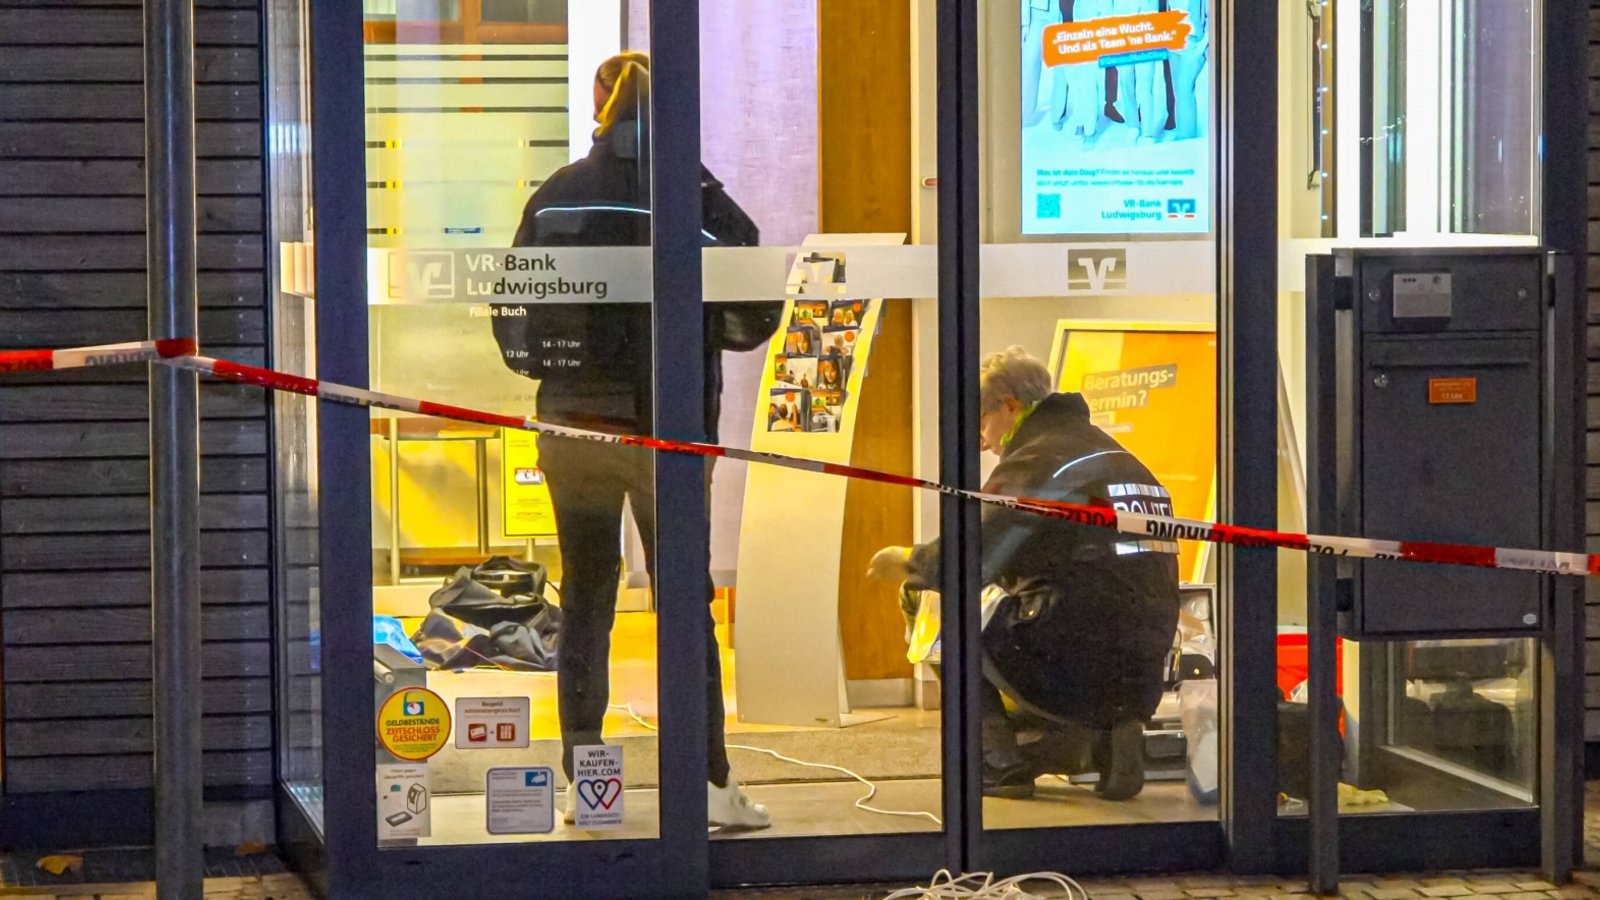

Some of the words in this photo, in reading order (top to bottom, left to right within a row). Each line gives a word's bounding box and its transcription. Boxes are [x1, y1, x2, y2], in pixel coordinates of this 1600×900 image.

[1096, 28, 1117, 38] eine
[1119, 22, 1154, 35] Wucht.
[1058, 42, 1080, 55] Und
[1082, 41, 1097, 52] als
[1100, 38, 1126, 50] Team
[1101, 210, 1162, 220] Ludwigsburg
[466, 277, 608, 299] Ludwigsburg
[501, 306, 527, 317] Buch
[542, 340, 551, 348] 14
[557, 340, 566, 348] 17
[567, 340, 581, 348] Uhr
[516, 350, 529, 358] Uhr
[542, 359, 551, 367] 14
[557, 359, 566, 367] 17
[567, 359, 581, 367] Uhr
[1084, 368, 1174, 391] Beratungs-
[1090, 389, 1147, 411] ermin?
[386, 726, 441, 736] ZEITSCHLOSS
[392, 733, 438, 743] GESICHERT
[587, 750, 610, 758] WIR-
[579, 759, 619, 768] KAUFEN-
[577, 768, 621, 777] HIER.COM
